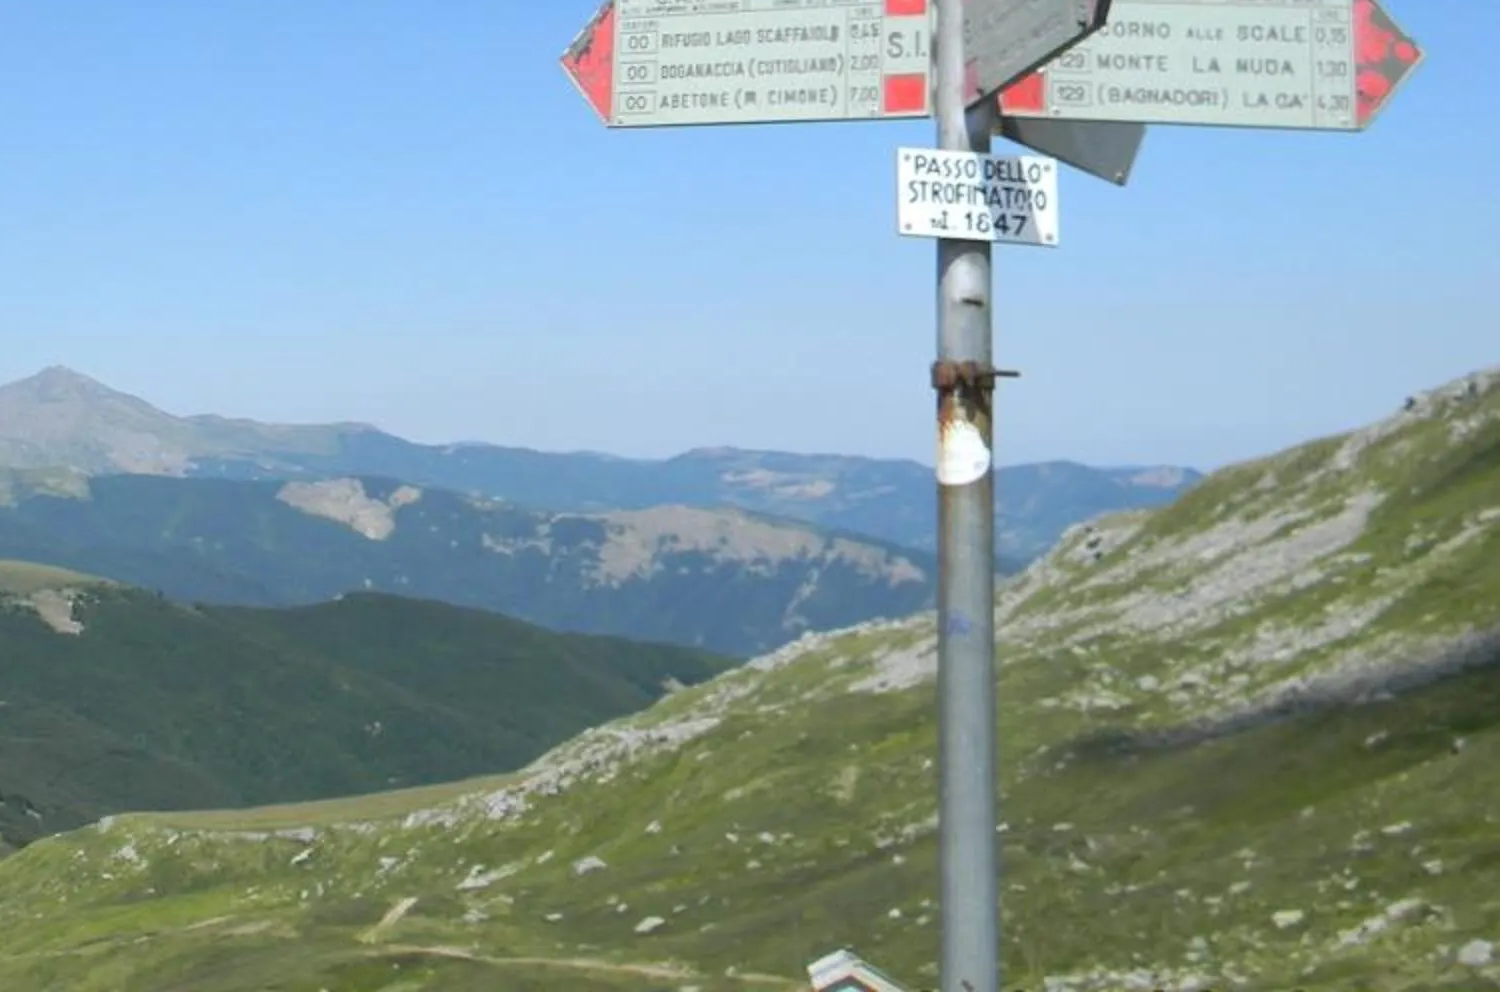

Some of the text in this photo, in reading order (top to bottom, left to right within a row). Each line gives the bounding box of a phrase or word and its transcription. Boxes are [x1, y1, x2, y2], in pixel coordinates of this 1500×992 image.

[627, 35, 650, 49] 00
[660, 31, 711, 49] RIFUGIO
[715, 29, 751, 46] LAGO
[1186, 27, 1223, 42] ALLE
[1236, 24, 1307, 44] SCALE
[627, 64, 649, 81] 00
[660, 61, 745, 80] DOGANACCIA
[1097, 53, 1169, 72] MONTE
[1192, 55, 1220, 74] LA
[1235, 57, 1295, 76] NUDA
[626, 94, 649, 111] 00
[660, 91, 730, 110] ABETONE
[768, 84, 839, 107] CIMONE)
[1097, 82, 1229, 110] (BAGNADORI)
[1242, 92, 1268, 109] LA
[914, 155, 1041, 185] PASSO DELLO
[964, 211, 1028, 237] 1647
